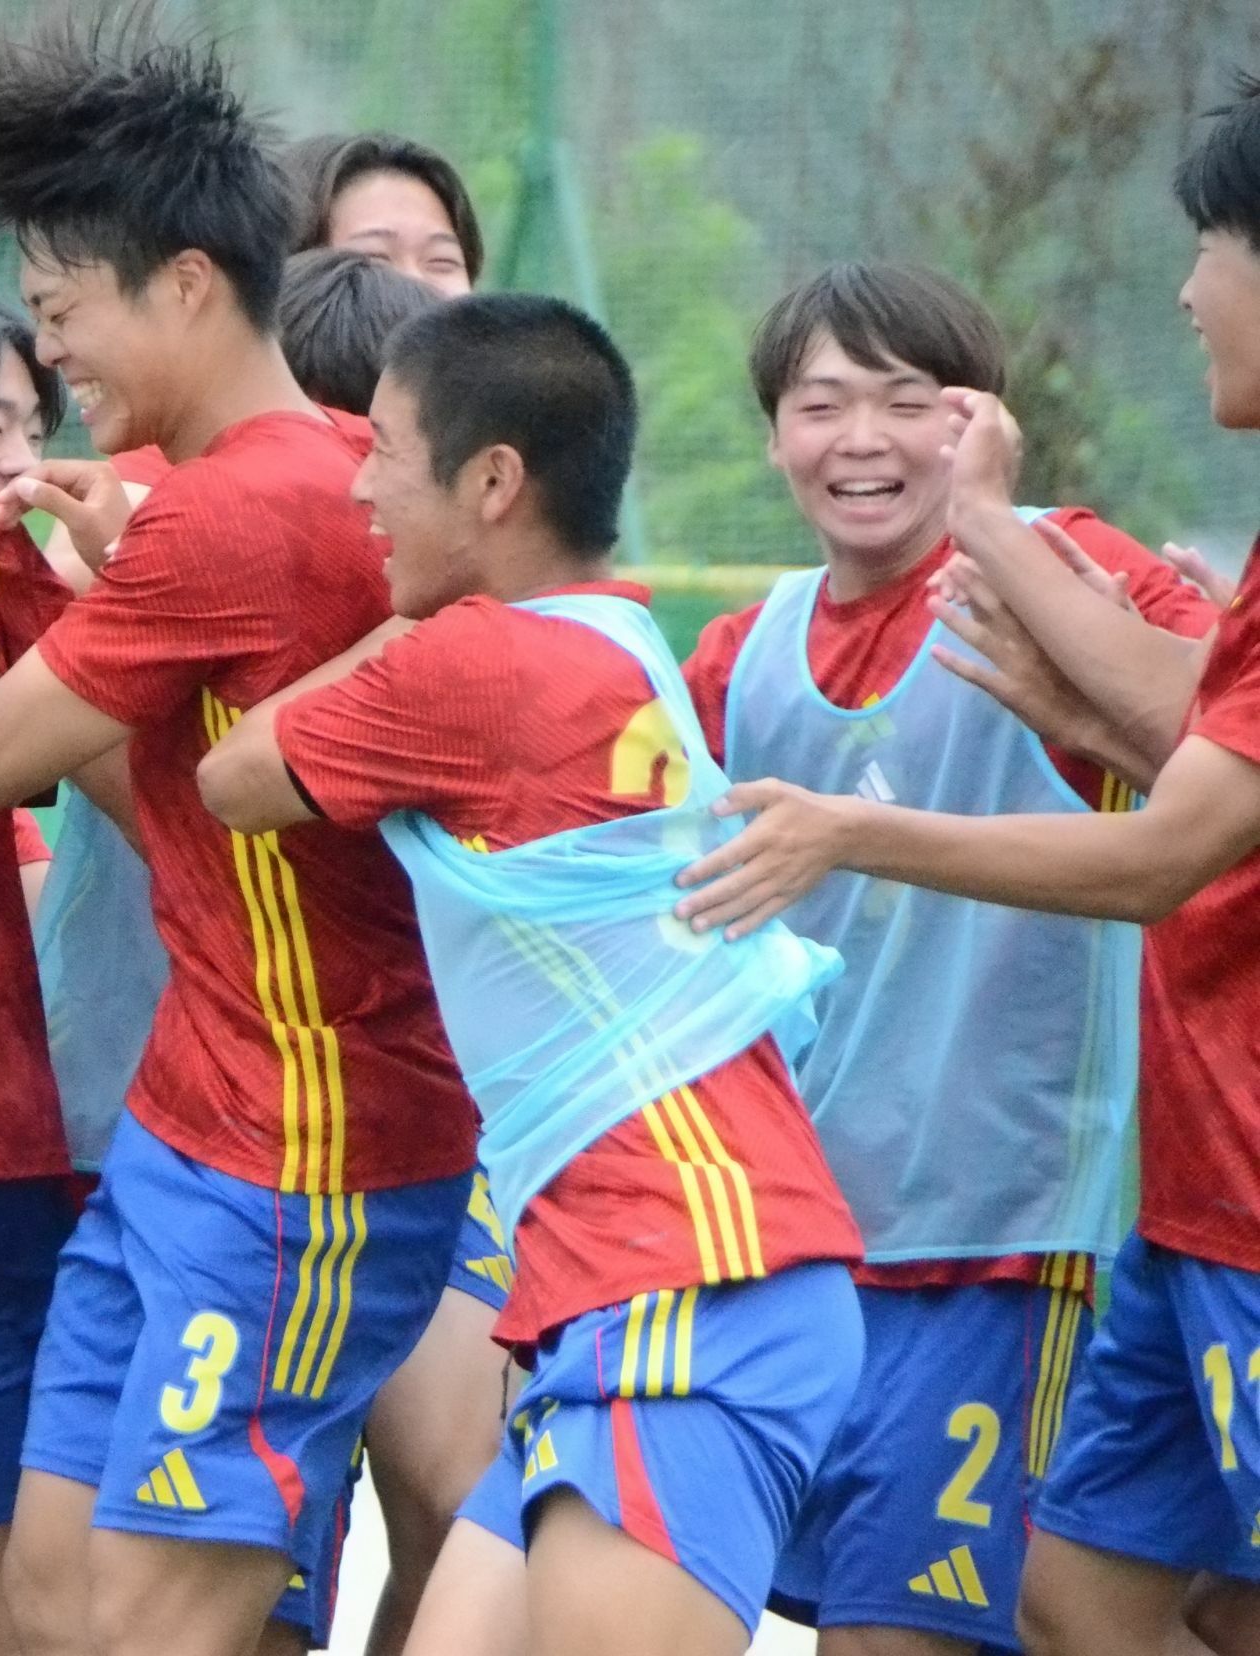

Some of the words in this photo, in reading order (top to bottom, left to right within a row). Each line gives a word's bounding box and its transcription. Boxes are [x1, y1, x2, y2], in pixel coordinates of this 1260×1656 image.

[160, 1312, 240, 1433] 3
[1202, 1343, 1260, 1471] 1
[938, 1403, 1000, 1526] 2
